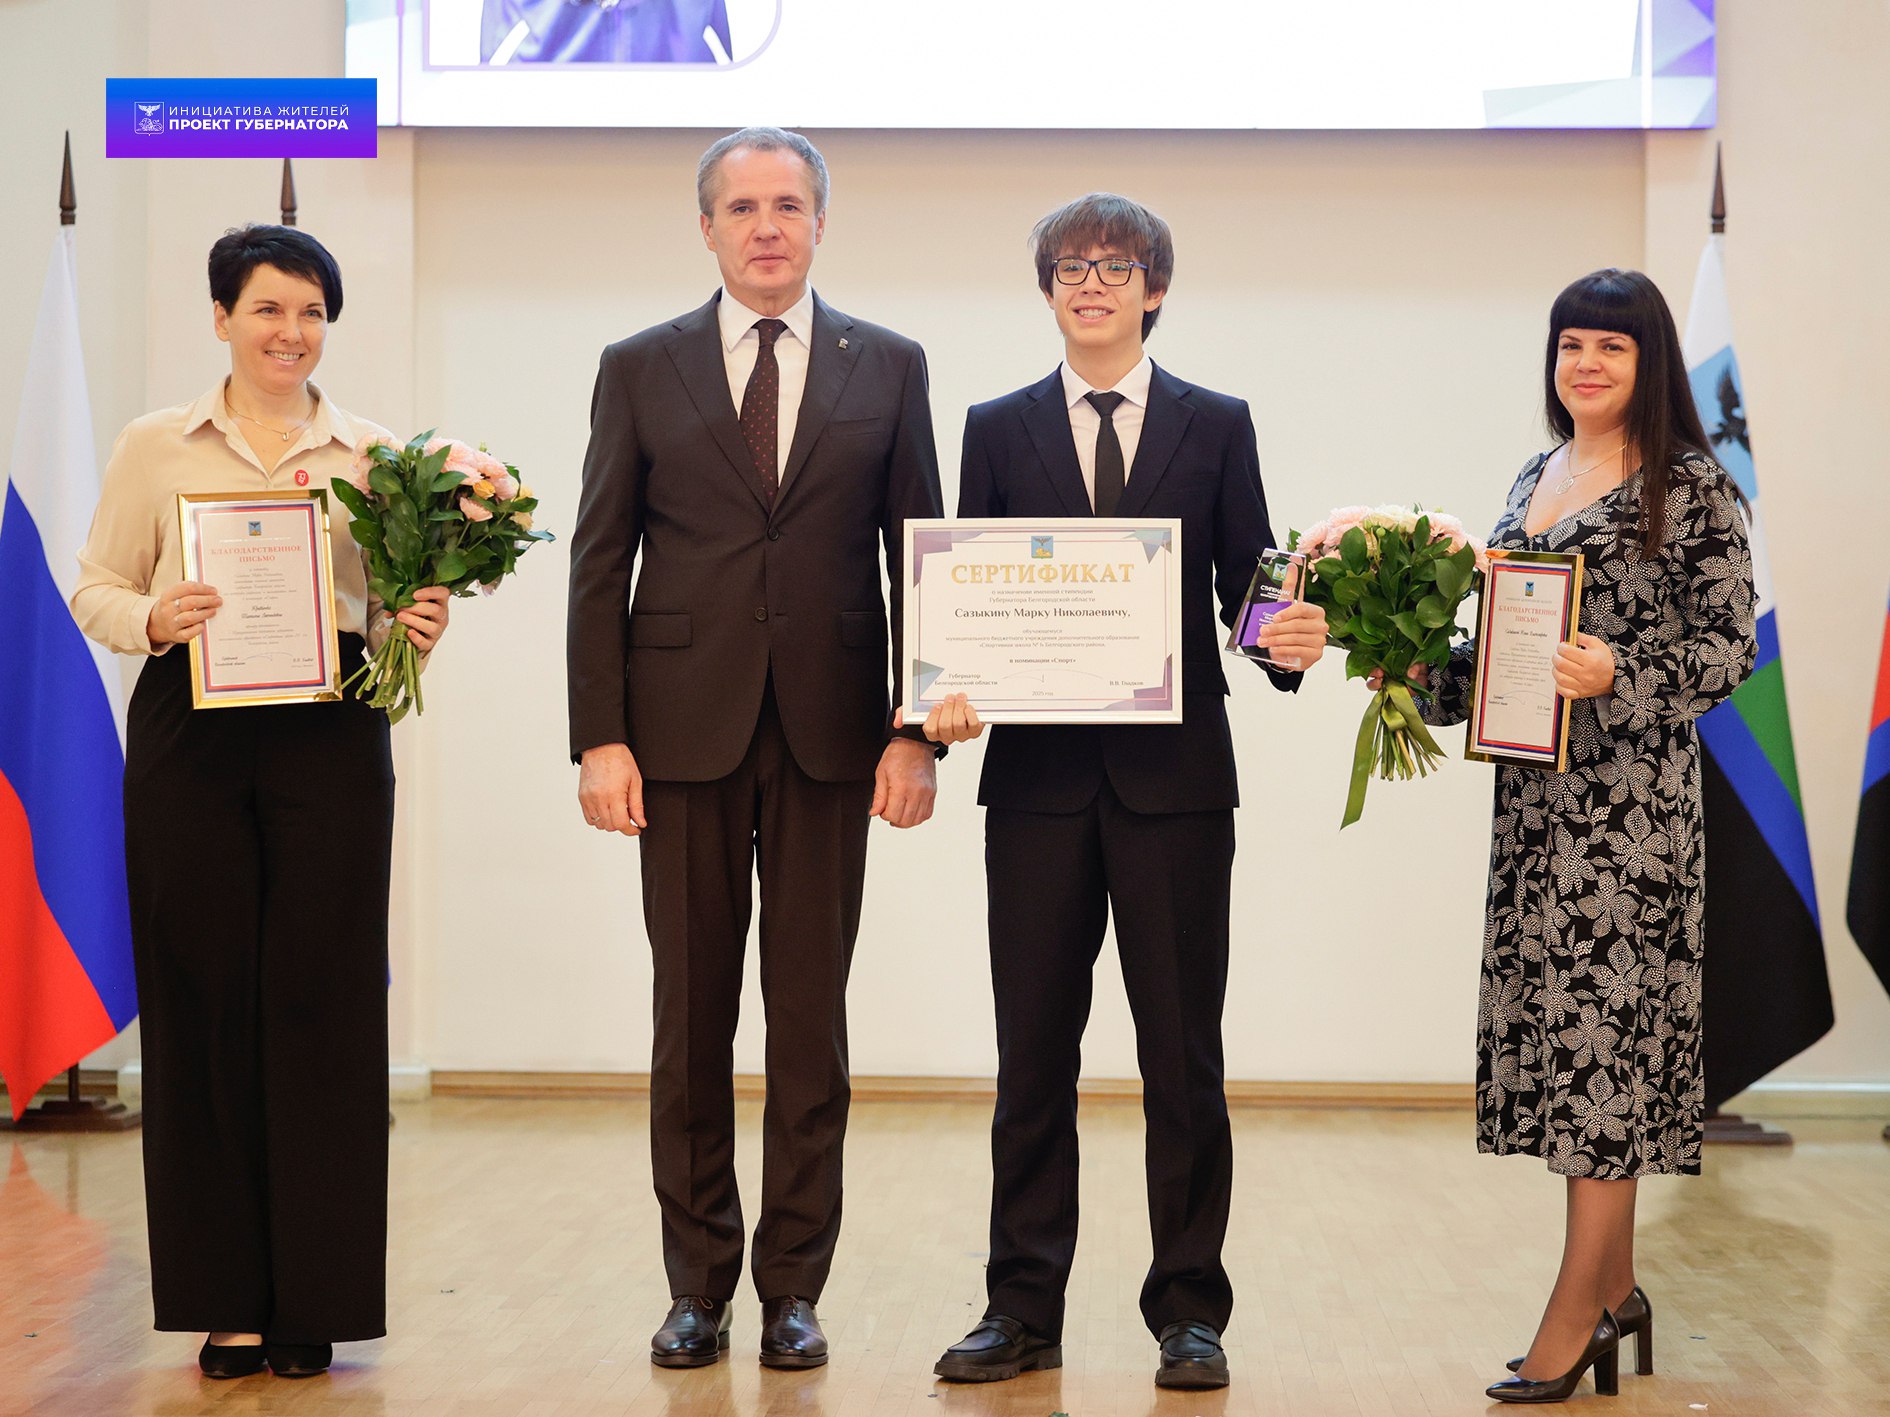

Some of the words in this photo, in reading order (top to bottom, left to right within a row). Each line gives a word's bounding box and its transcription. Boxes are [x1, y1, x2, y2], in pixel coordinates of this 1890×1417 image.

[211, 545, 302, 556] БЛАГОДАРСТВЕННОЕ
[239, 555, 276, 563] ПИСЬМО
[951, 563, 1135, 584] СЕРТИФИКАТ
[989, 596, 1027, 604] Губернатора
[954, 608, 1011, 619] Сазыкину
[1013, 608, 1050, 619] Марку
[1053, 607, 1131, 619] Николаевичу,
[1498, 606, 1557, 616] БЛАГОДАРСТВЕННОЕ
